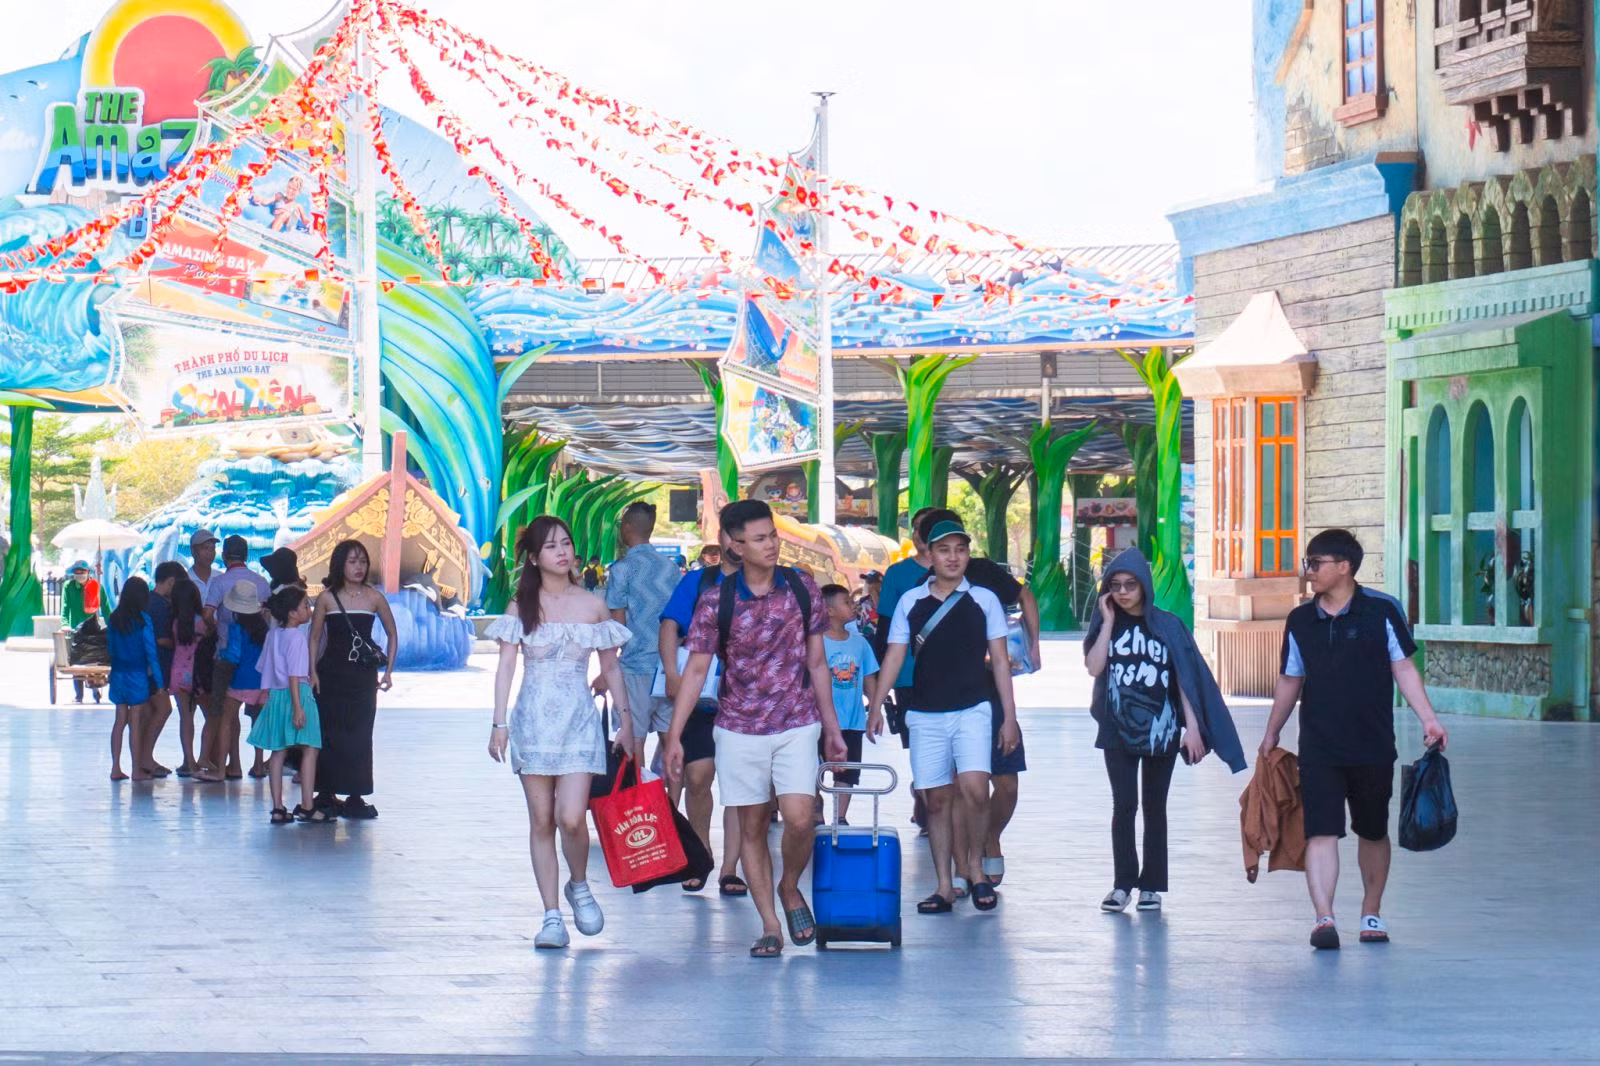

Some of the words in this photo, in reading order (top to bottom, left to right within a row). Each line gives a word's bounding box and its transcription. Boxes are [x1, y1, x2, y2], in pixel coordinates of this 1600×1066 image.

[84, 92, 139, 123] THE
[227, 255, 255, 272] BAY
[174, 354, 215, 373] THÀNH
[217, 347, 240, 363] PHỐ
[243, 351, 258, 361] DU
[196, 369, 213, 380] THE
[214, 365, 252, 376] AMAZING
[254, 365, 271, 375] BAY
[1367, 918, 1378, 929] C
